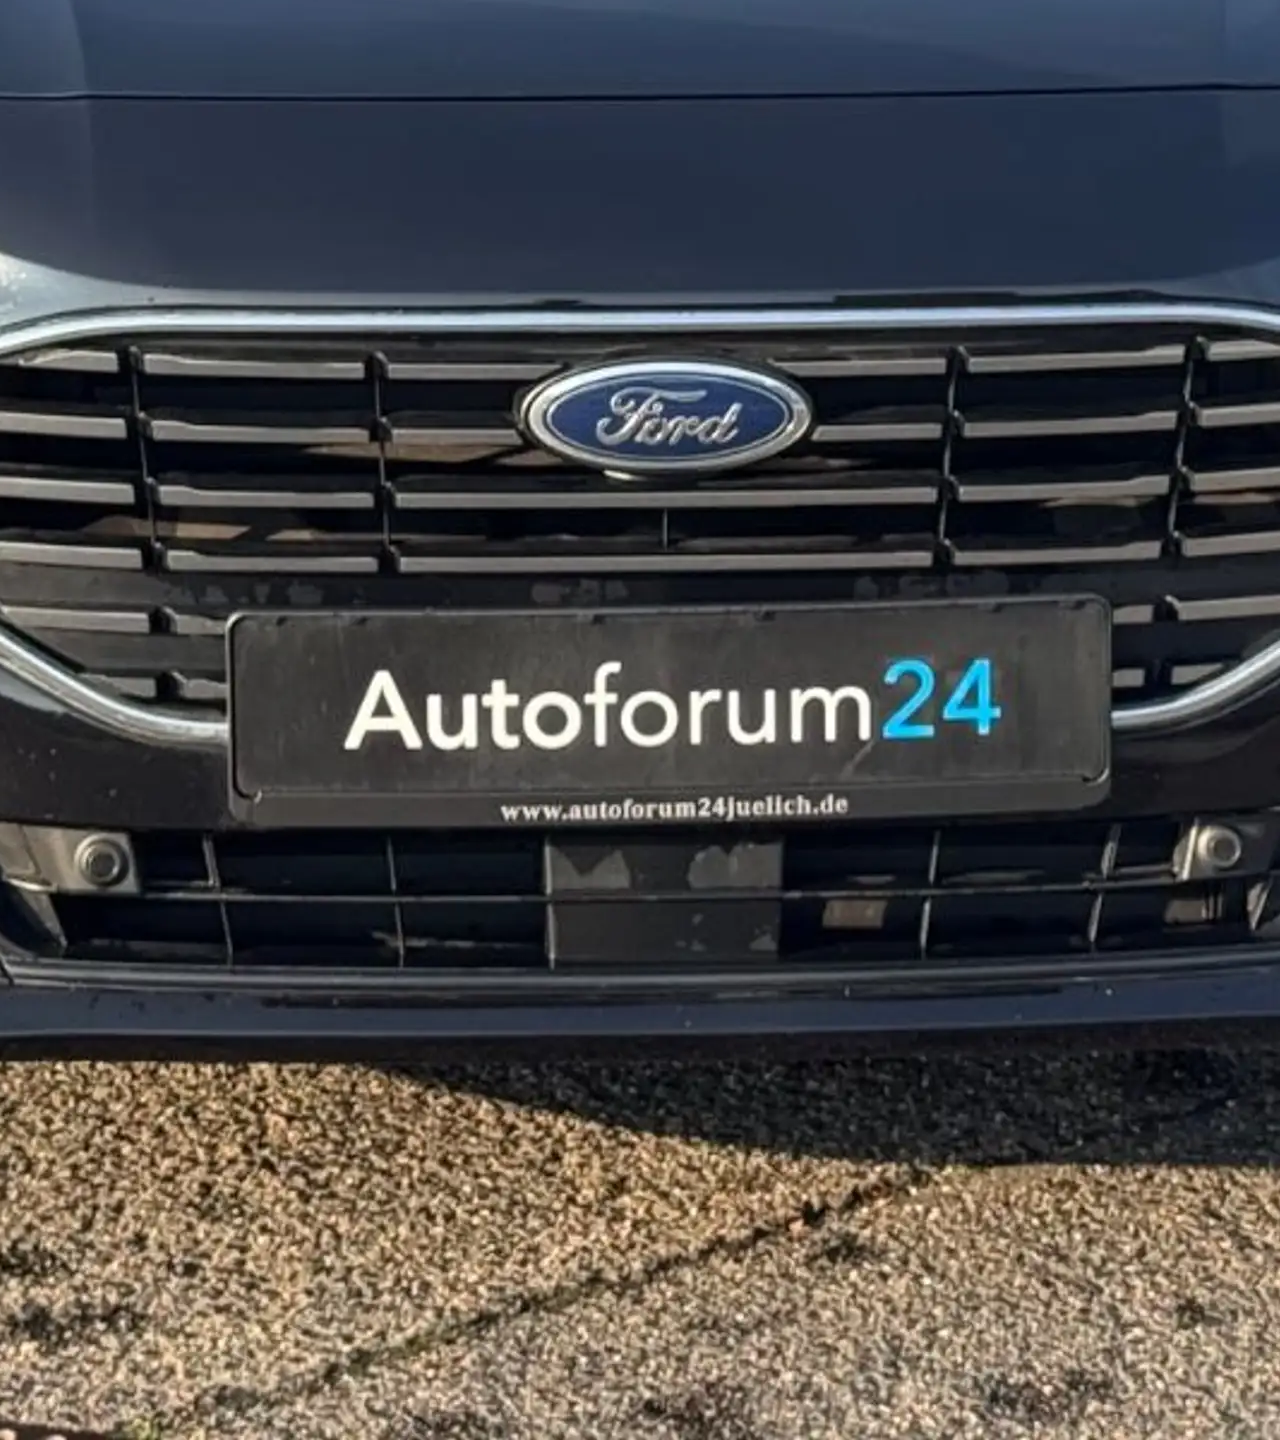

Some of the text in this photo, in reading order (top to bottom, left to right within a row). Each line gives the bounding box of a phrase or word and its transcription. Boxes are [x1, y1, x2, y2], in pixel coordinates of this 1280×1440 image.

[596, 386, 743, 446] Ford
[342, 657, 1003, 751] Autoforum24
[499, 793, 850, 822] www.autoforum24juelich.de
